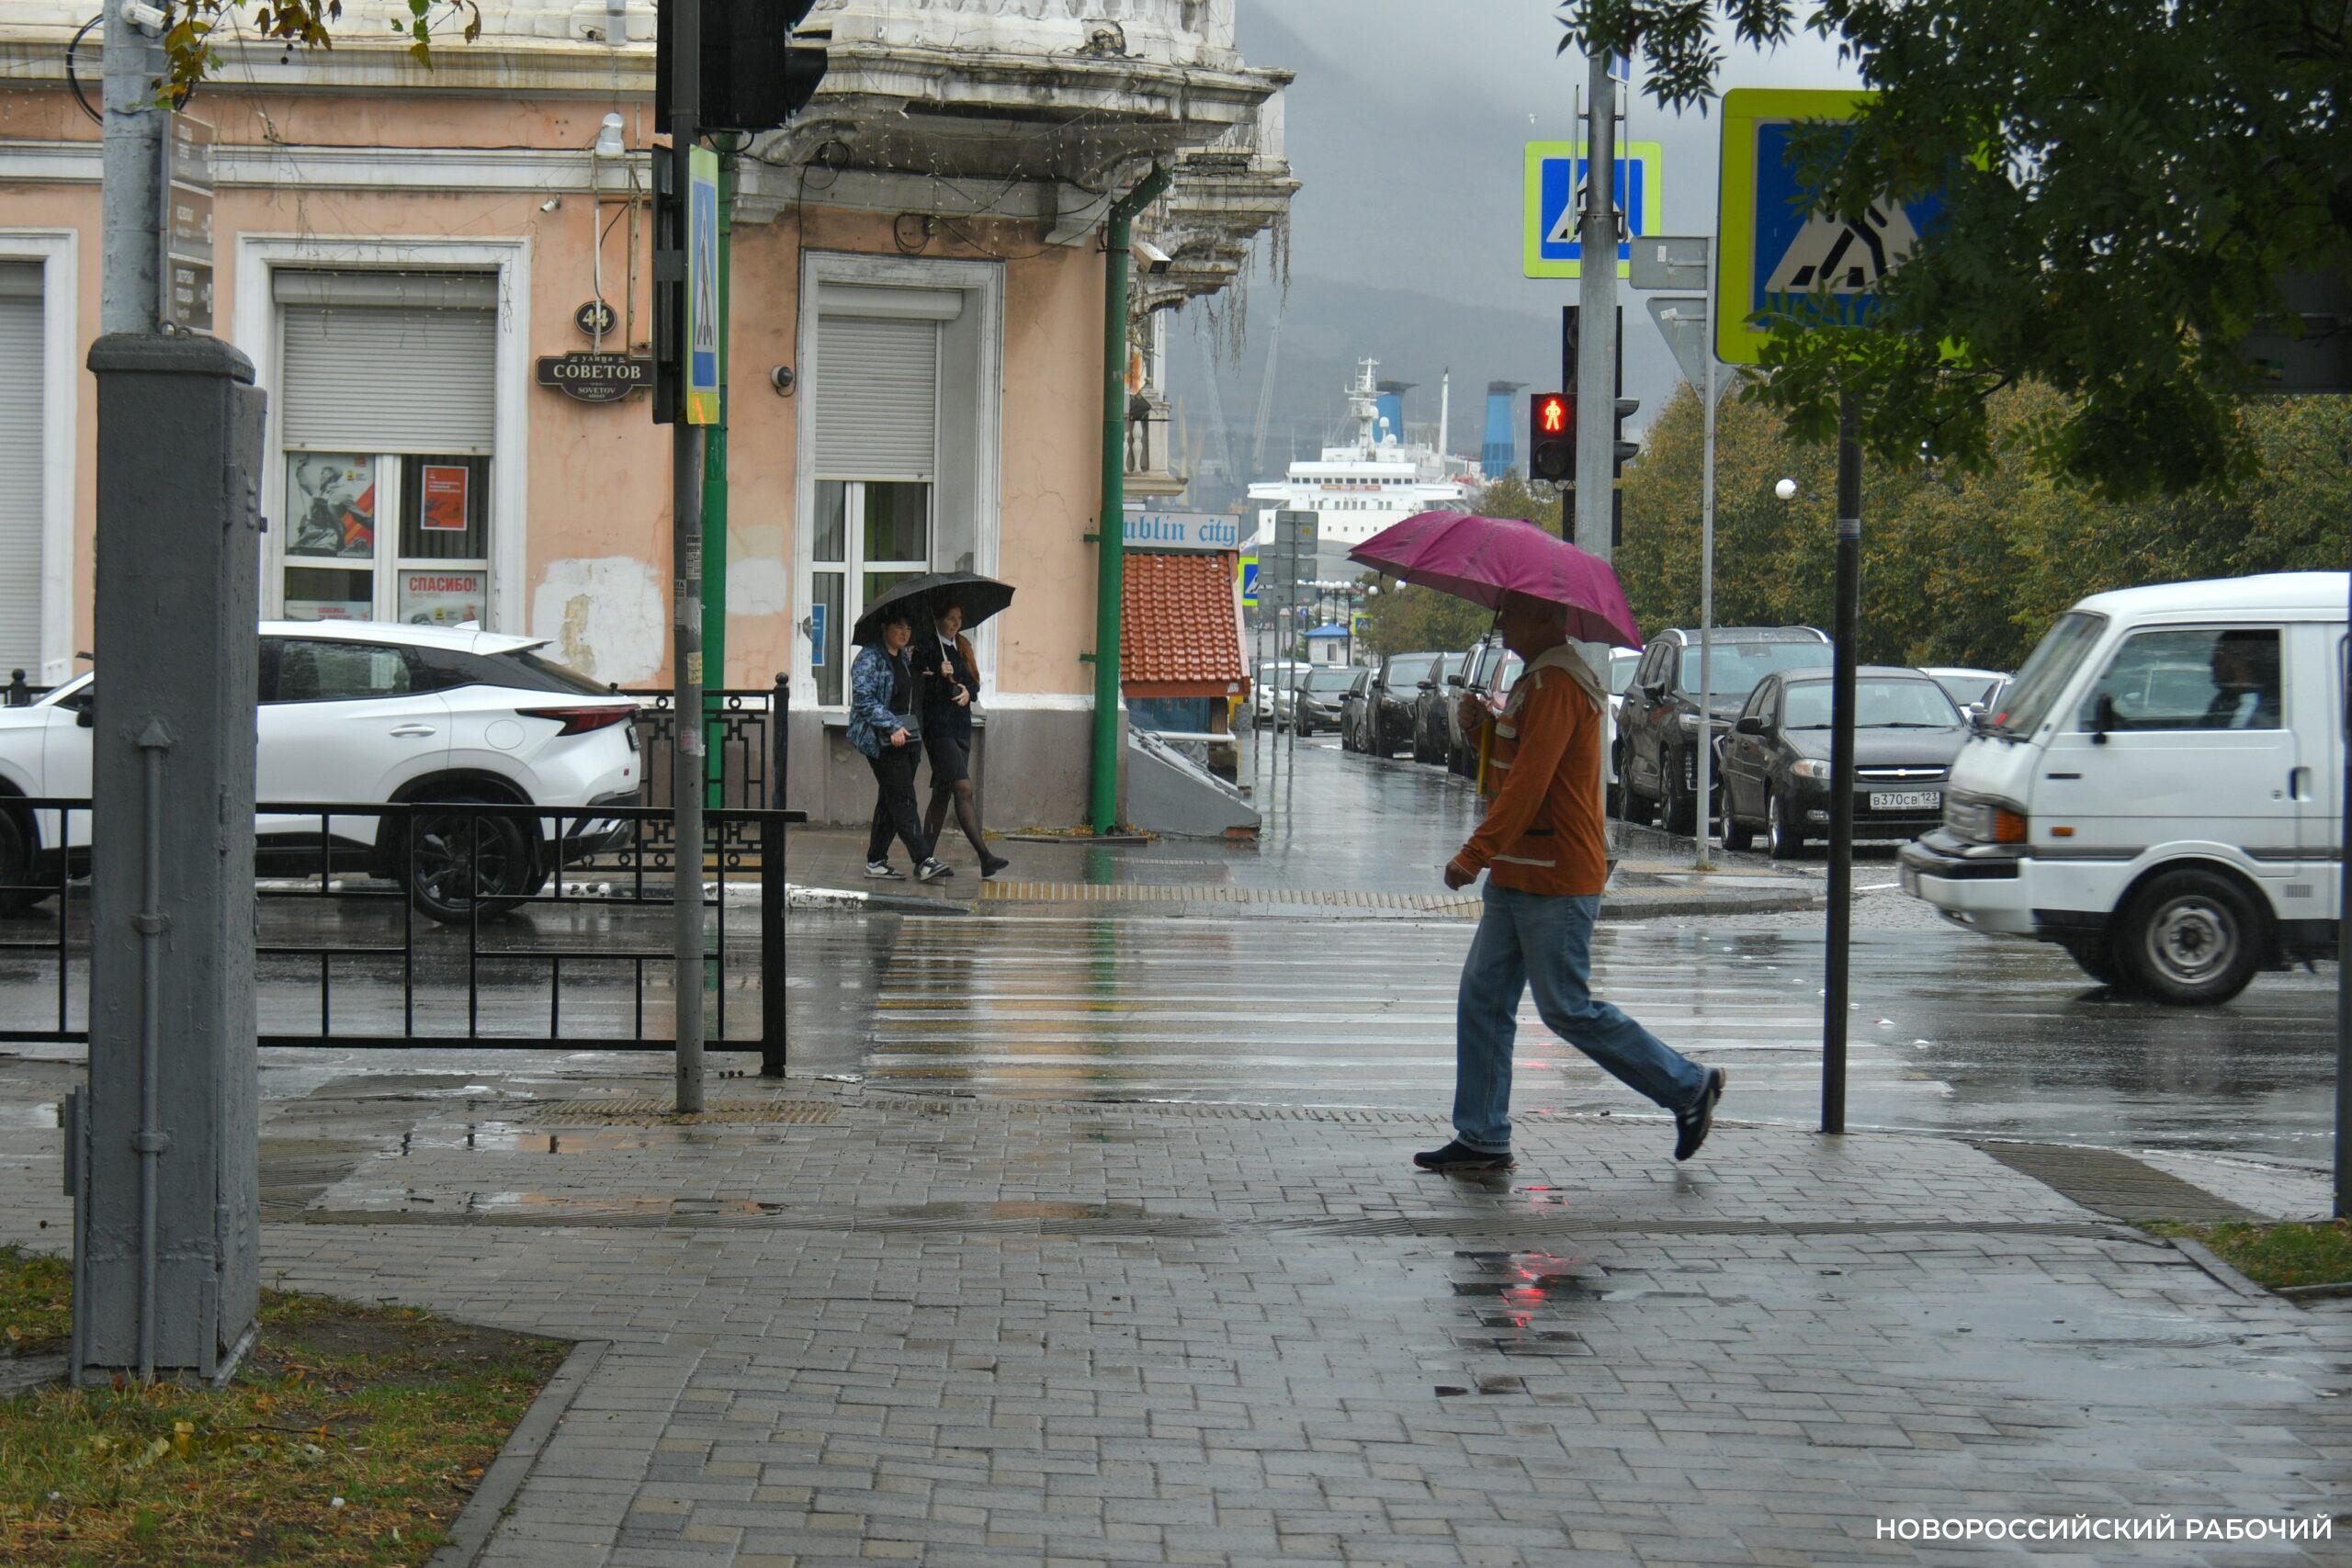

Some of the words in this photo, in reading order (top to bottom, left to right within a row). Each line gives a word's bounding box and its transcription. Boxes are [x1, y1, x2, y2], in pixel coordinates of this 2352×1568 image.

[582, 309, 609, 327] 44
[553, 365, 641, 378] СОВЕТОВ
[1123, 515, 1185, 540] ublin
[1199, 519, 1236, 547] city
[409, 576, 478, 592] СПАСИБО!
[1873, 794, 1917, 806] В370СВ
[1920, 793, 1938, 802] 123
